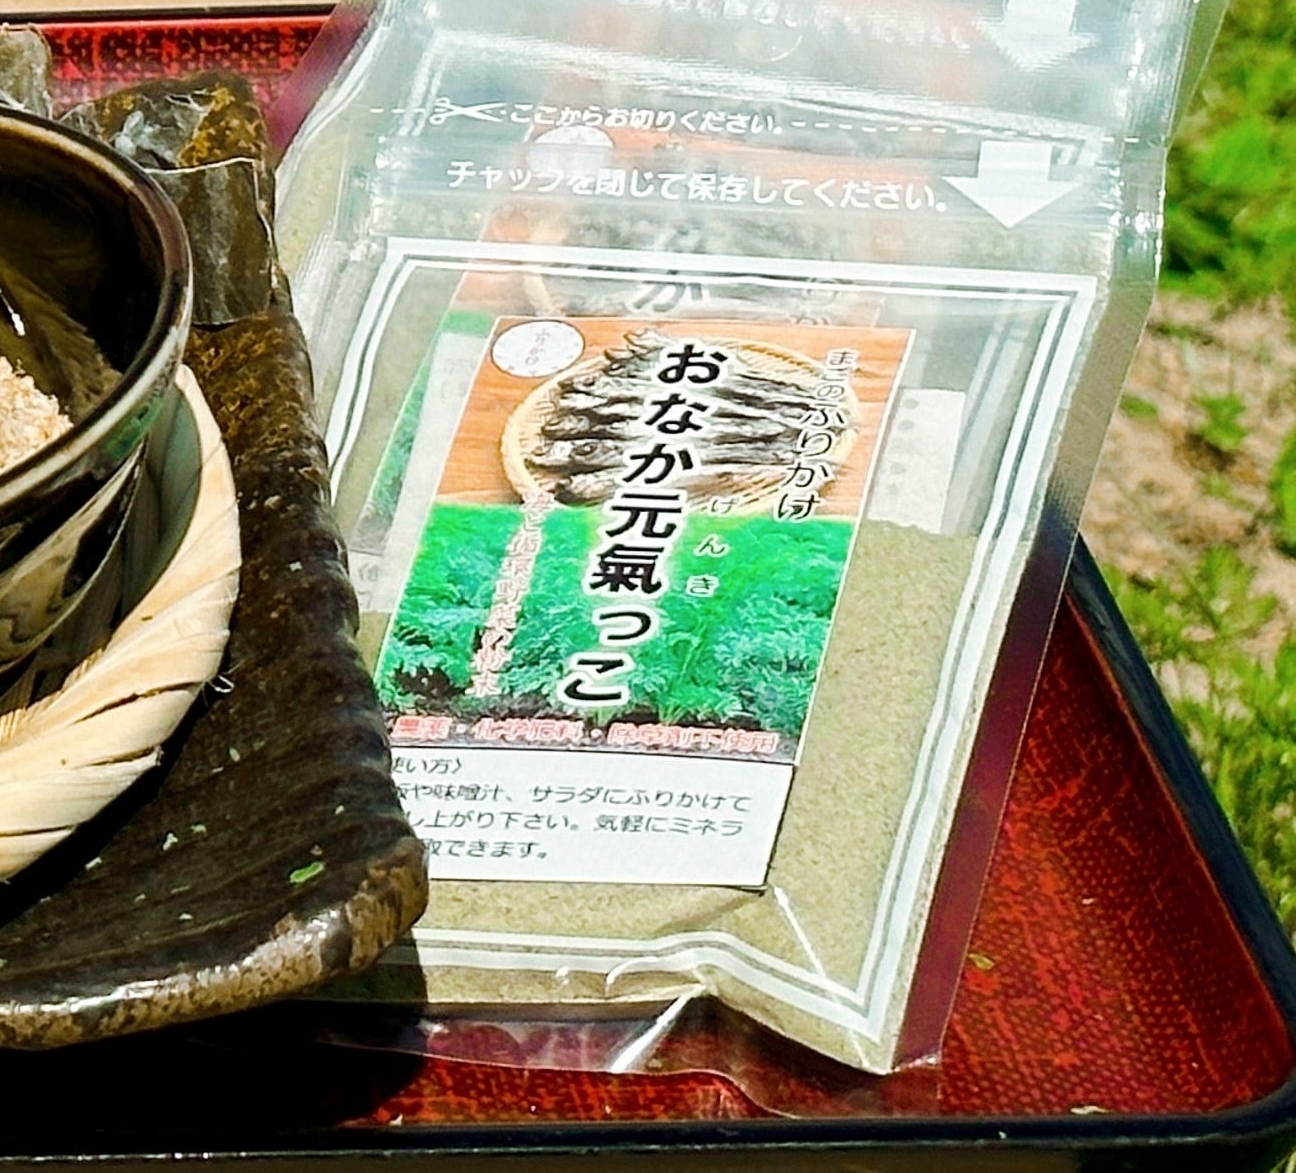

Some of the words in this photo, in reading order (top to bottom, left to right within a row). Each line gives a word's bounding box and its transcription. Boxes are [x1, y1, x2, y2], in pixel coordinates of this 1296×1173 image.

[509, 102, 782, 135] ここからお切りください。
[446, 159, 948, 212] チャックを閉じて保存してください。
[777, 350, 855, 520] まこのふりかけ
[559, 342, 726, 704] おなか元氣っこ
[396, 782, 753, 814] や味噌汁、サラダにふりかけて
[406, 810, 744, 838] し上がり下さい。気軽にミネラ
[422, 836, 550, 861] 取できます。
